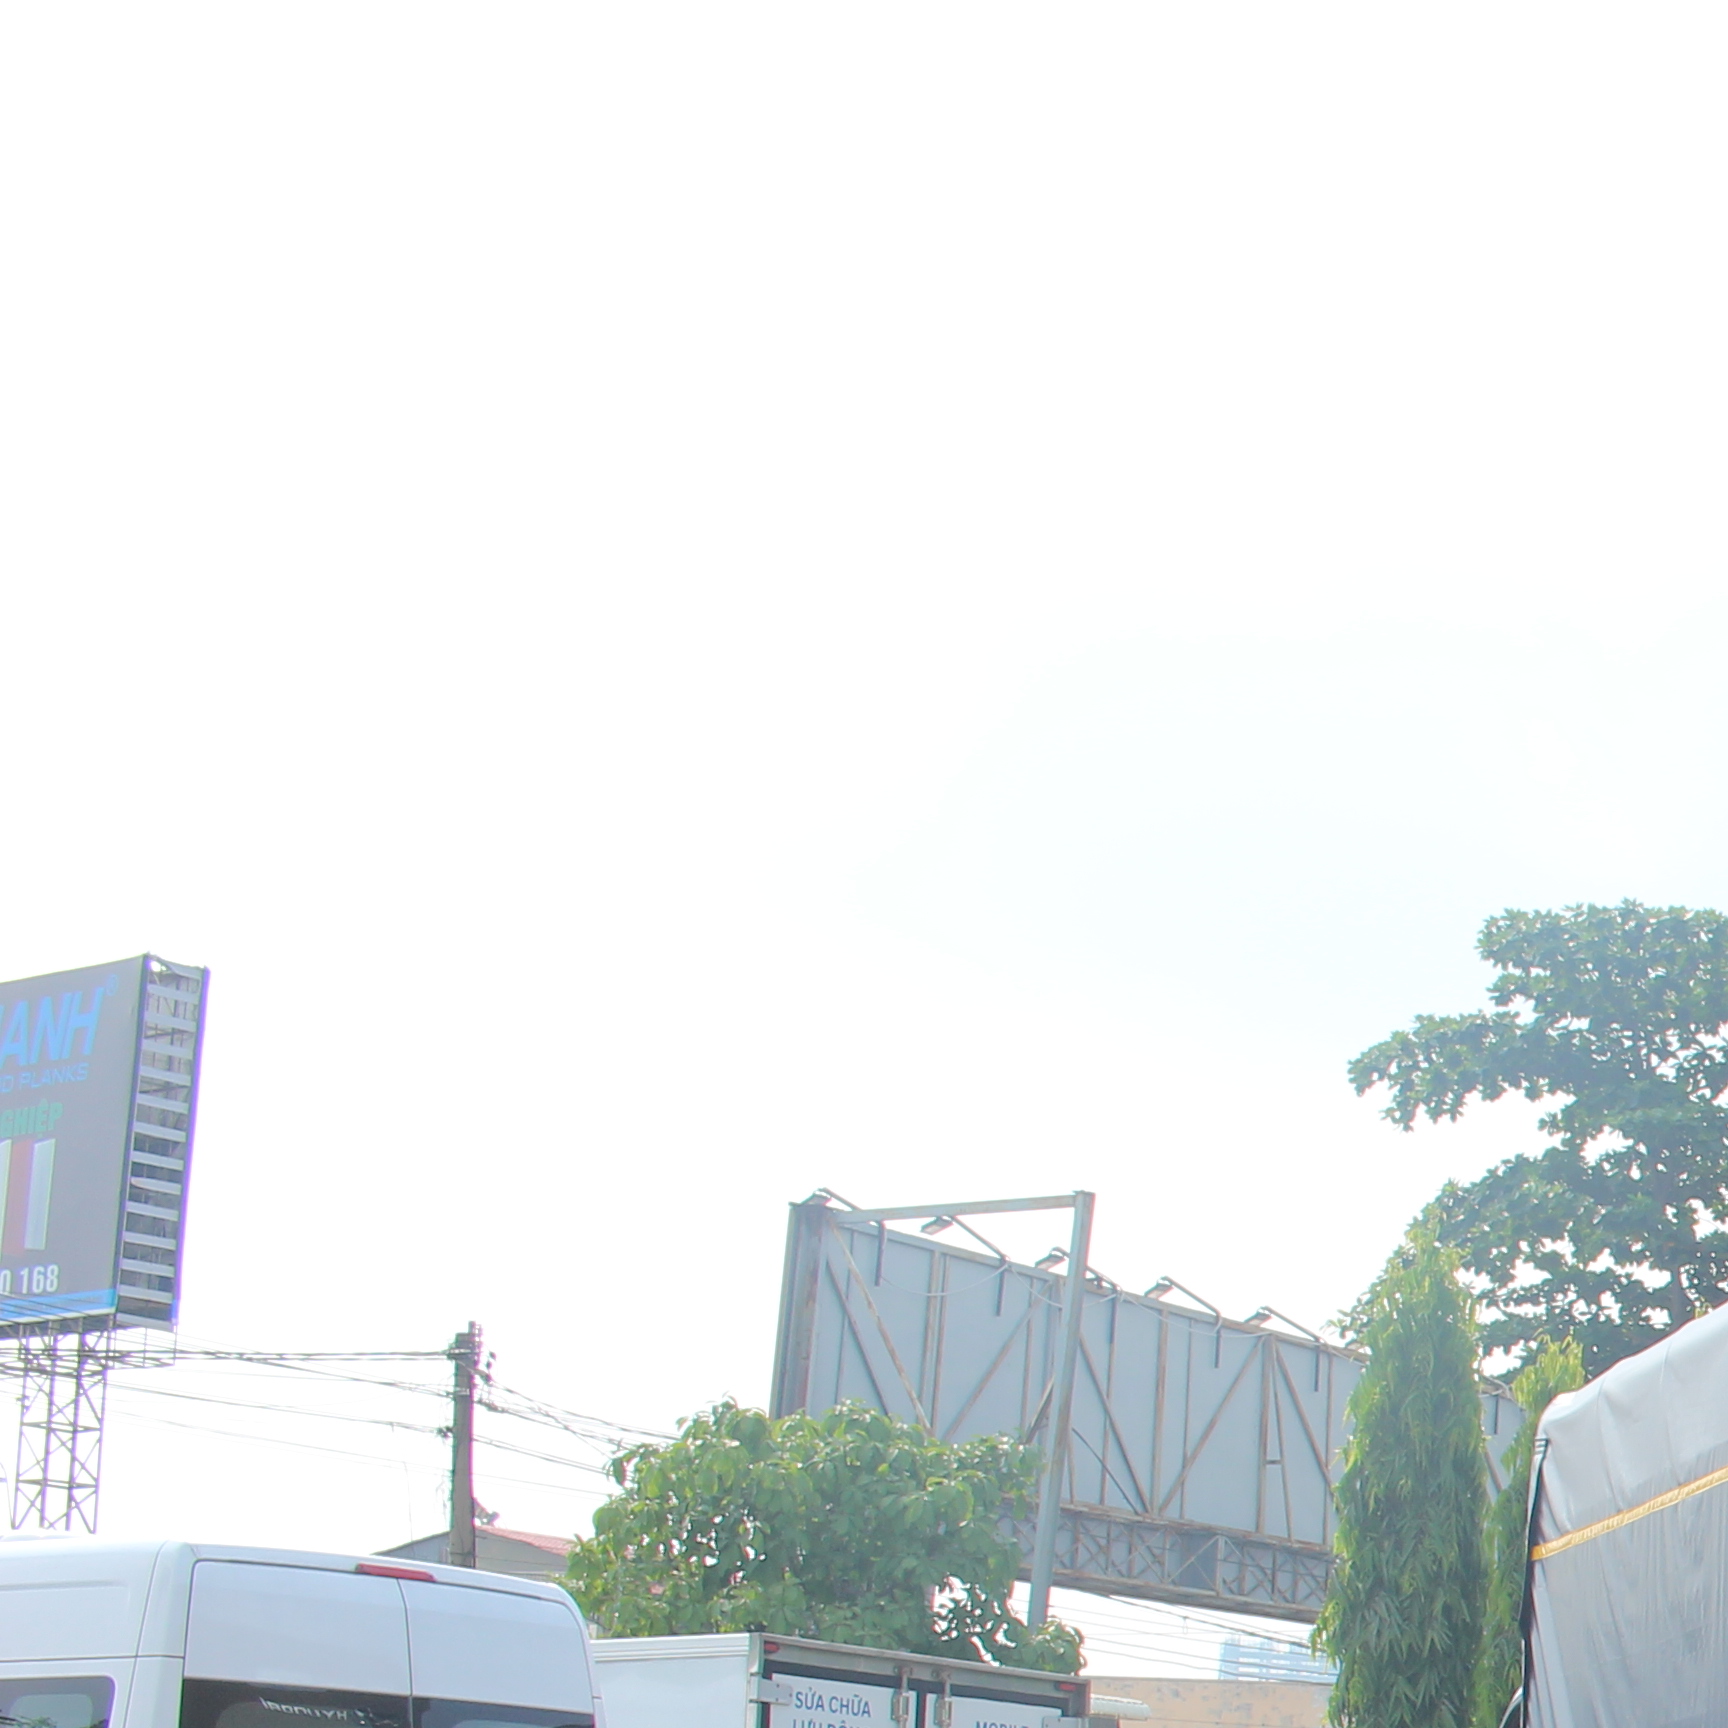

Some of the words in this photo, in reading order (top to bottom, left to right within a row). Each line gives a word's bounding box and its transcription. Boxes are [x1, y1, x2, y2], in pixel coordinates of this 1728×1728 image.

[0, 986, 105, 1070] ANH
[20, 1264, 59, 1294] 168
[795, 1687, 825, 1712] SỬA
[829, 1694, 871, 1718] CHỮA
